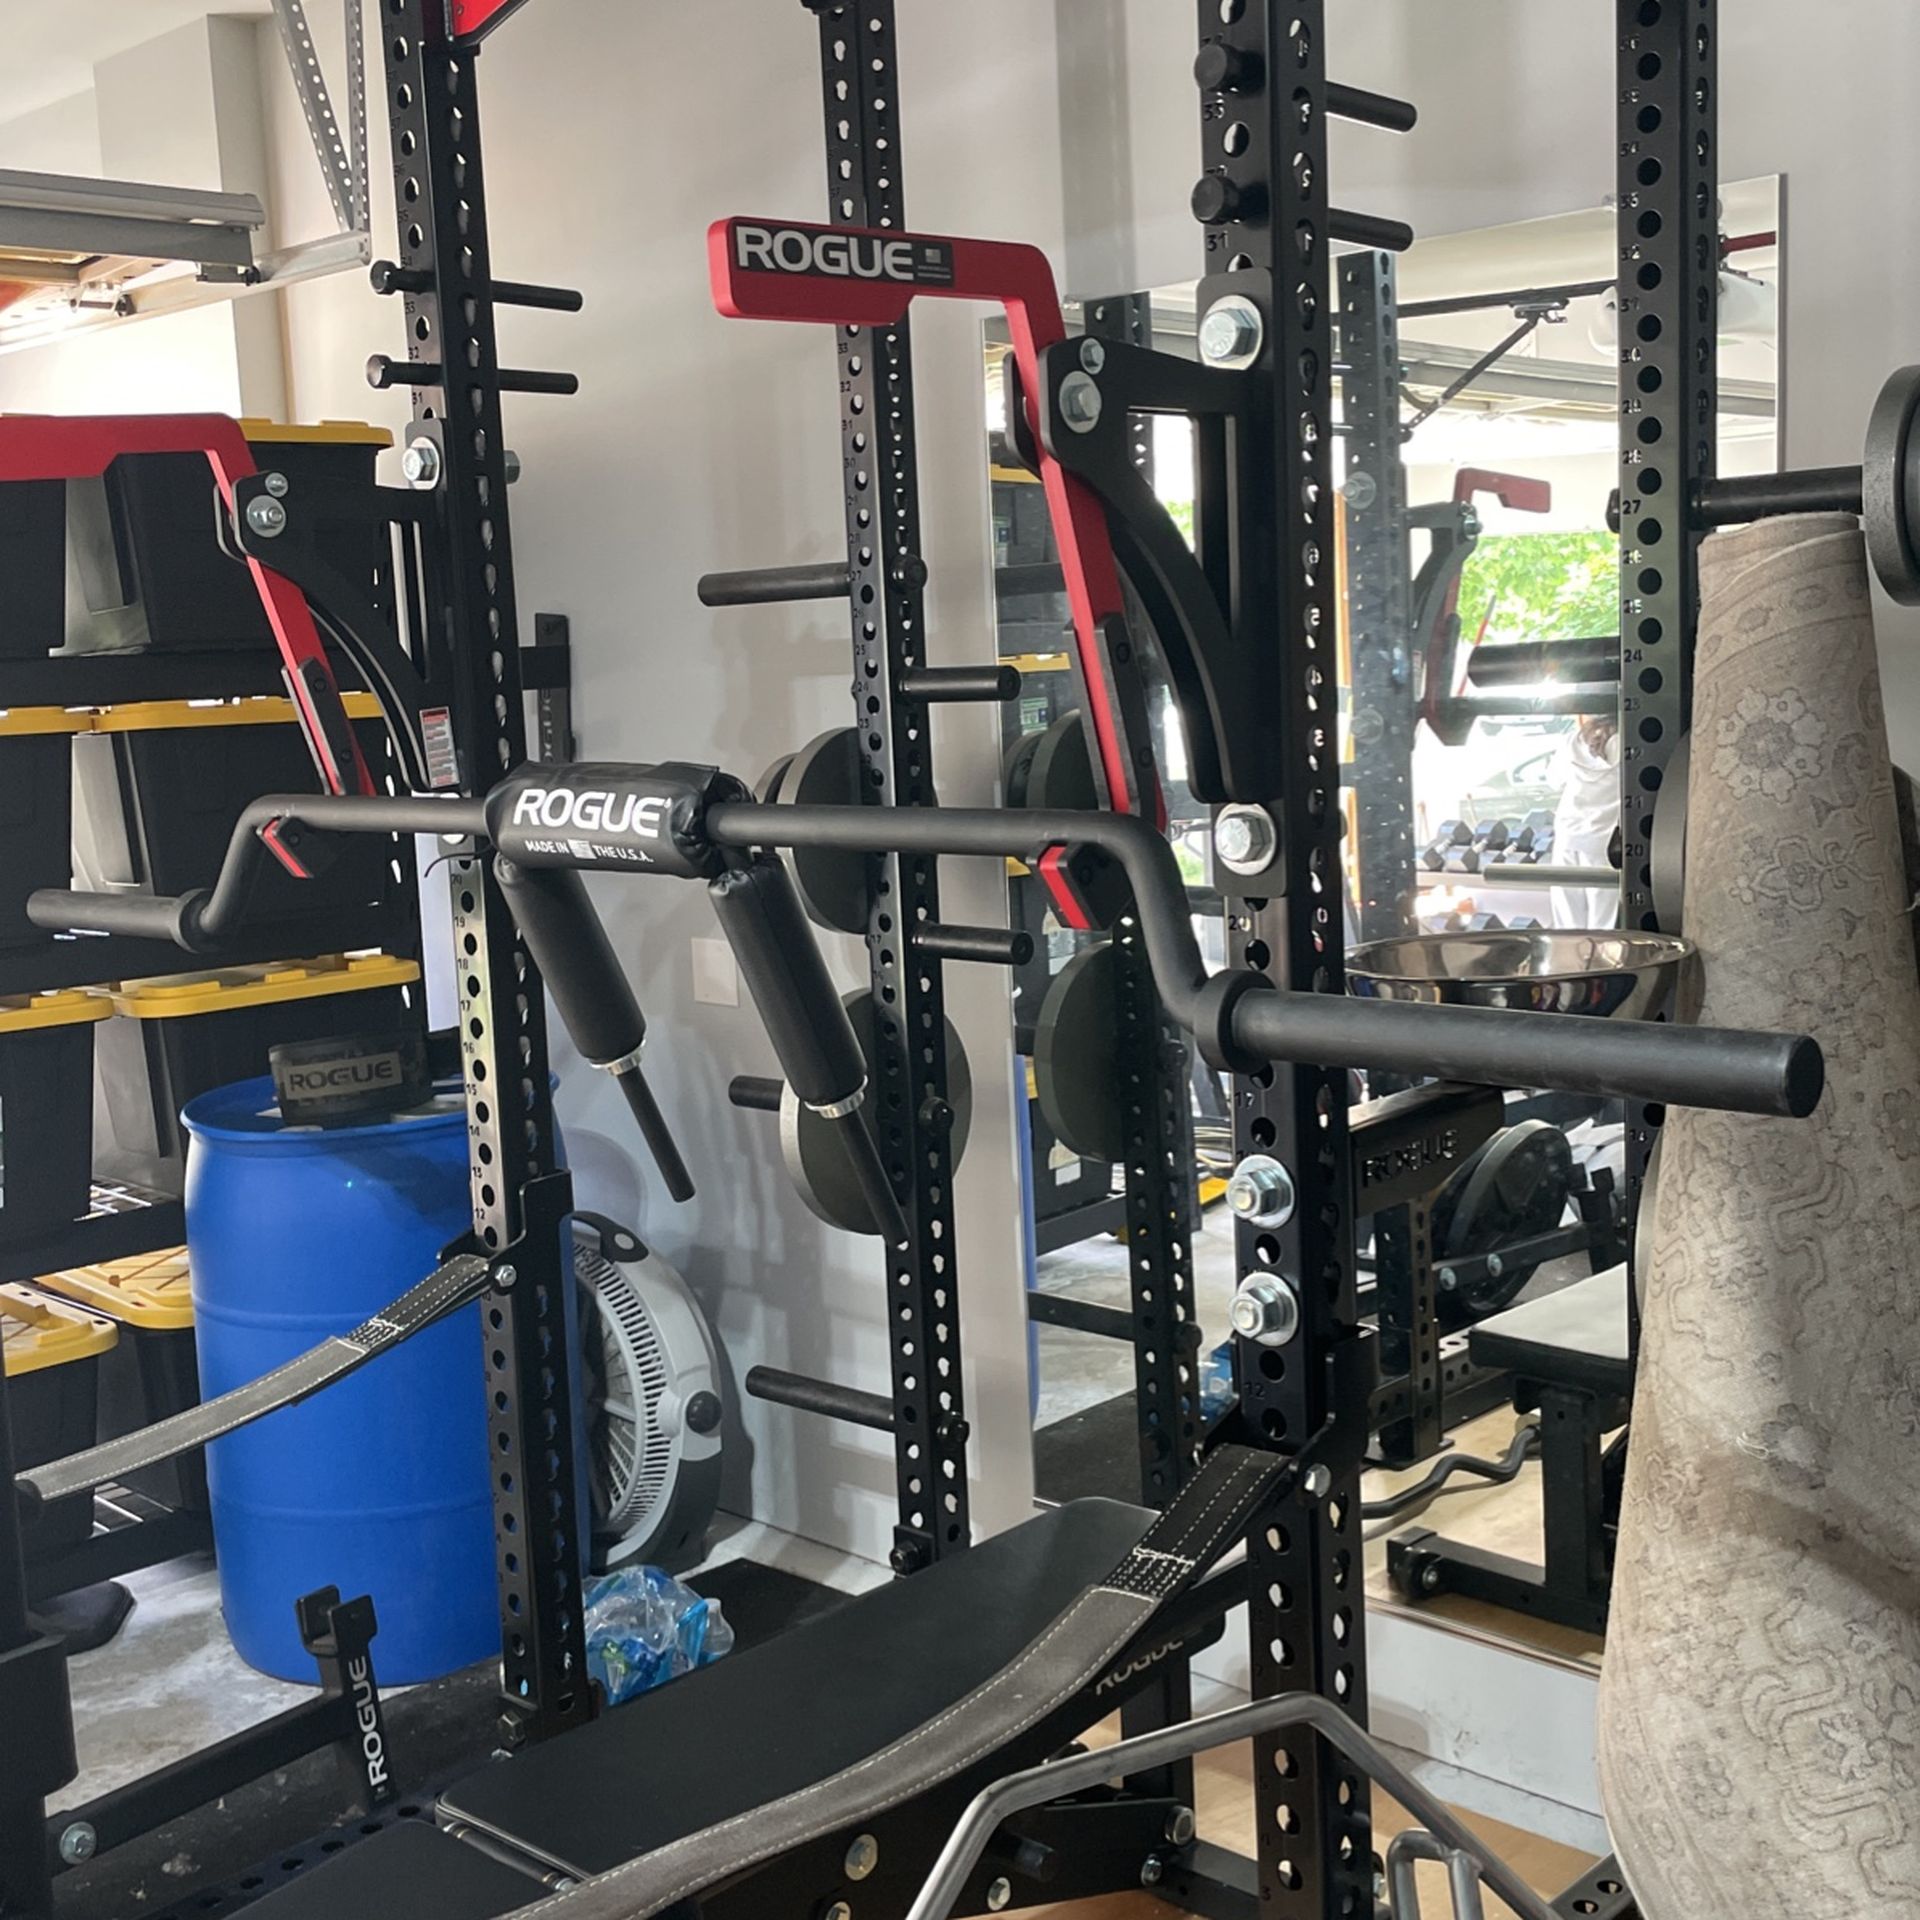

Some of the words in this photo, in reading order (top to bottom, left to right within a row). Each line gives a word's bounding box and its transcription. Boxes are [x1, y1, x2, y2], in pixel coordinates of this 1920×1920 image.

[735, 225, 914, 281] ROGUE
[1622, 499, 1642, 515] 27
[513, 788, 667, 839] ROGUE
[525, 840, 557, 854] MADE
[557, 841, 570, 854] IN
[592, 844, 618, 859] THE
[289, 1060, 393, 1092] ROGUE
[348, 1655, 388, 1787] ROGUE
